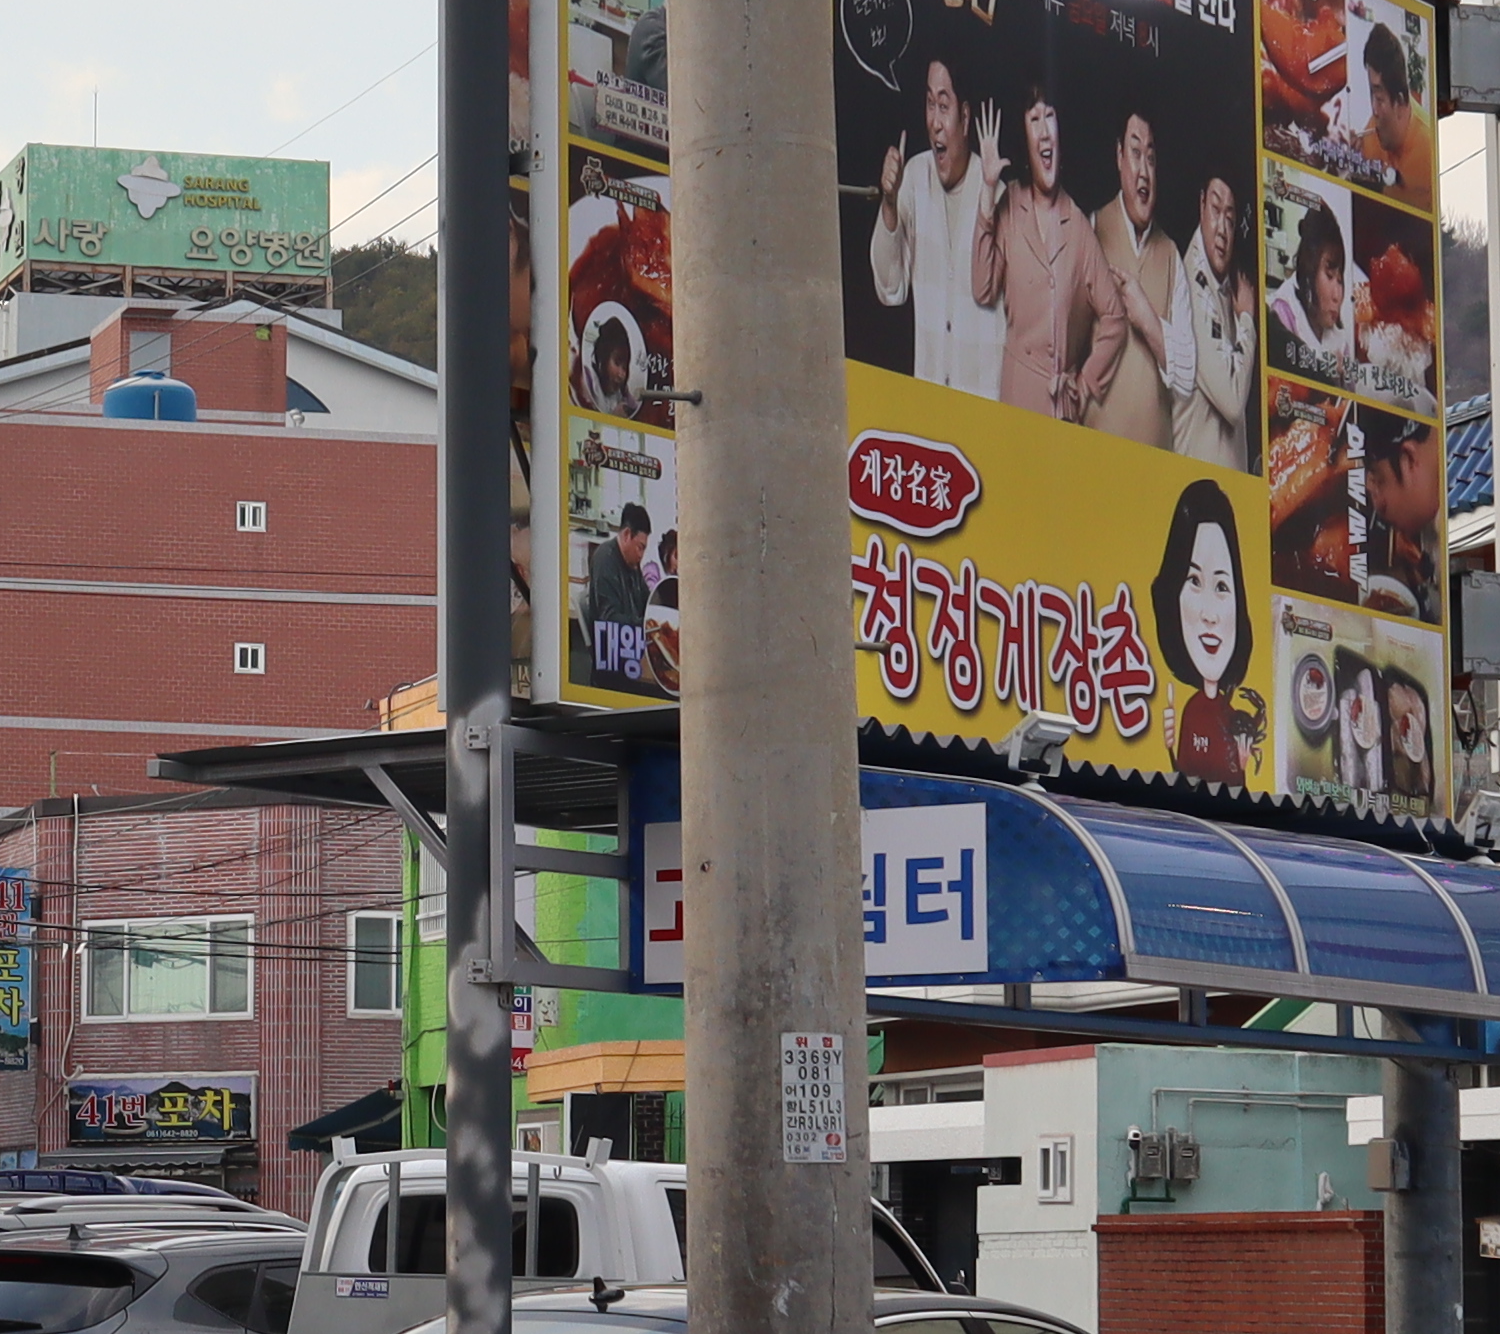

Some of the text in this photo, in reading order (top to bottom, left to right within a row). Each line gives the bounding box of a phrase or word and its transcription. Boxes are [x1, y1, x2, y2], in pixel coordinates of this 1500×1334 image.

[1109, 10, 1135, 49] 저녁
[183, 175, 249, 193] SARANG
[183, 194, 262, 212] HOSPITAL
[33, 217, 326, 269] 사랑 요양병원
[593, 620, 646, 680] 대왕
[852, 534, 1155, 738] 청정게장촌
[784, 1050, 842, 1065] 3369Y
[798, 1066, 830, 1080] 081
[75, 1088, 237, 1131] 41번 포차
